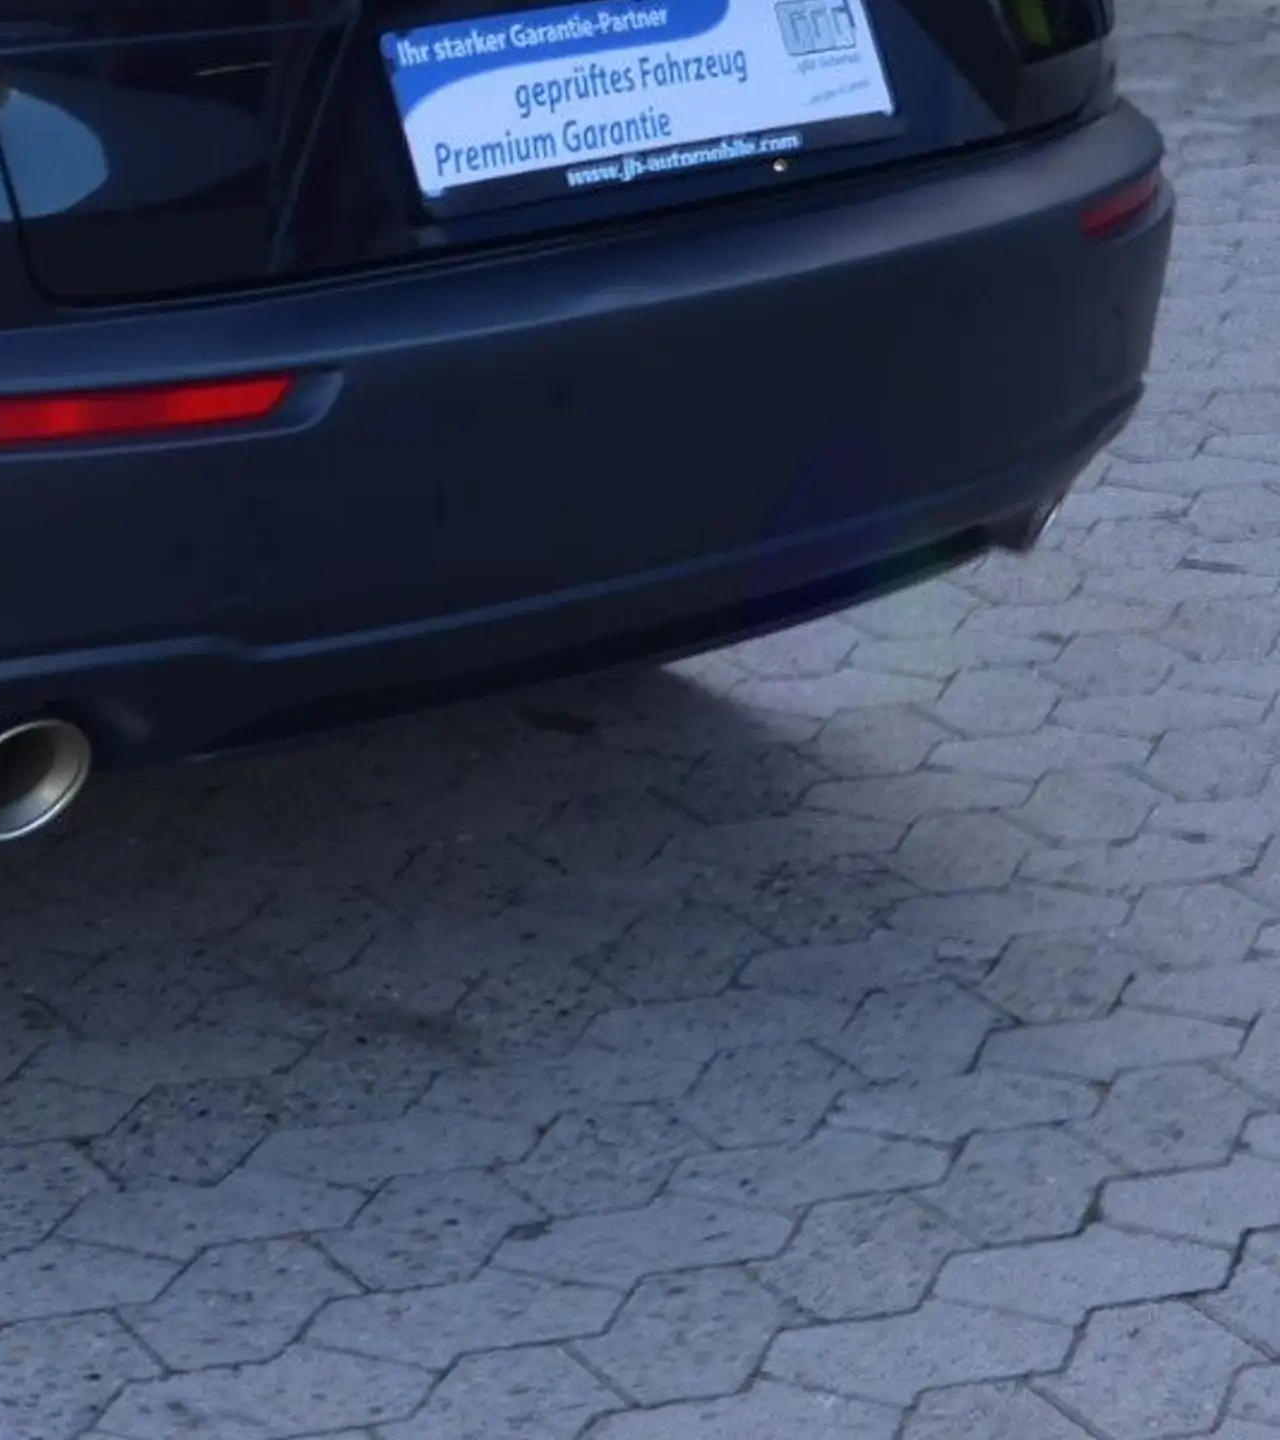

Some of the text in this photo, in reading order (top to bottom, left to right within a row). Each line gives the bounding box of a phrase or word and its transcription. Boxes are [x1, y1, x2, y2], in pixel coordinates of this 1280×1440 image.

[396, 7, 669, 67] Ihr starker Garantie-Partner
[514, 62, 636, 119] geprüftes
[638, 49, 748, 89] Fahrzeug
[434, 106, 673, 178] Premium Garantie
